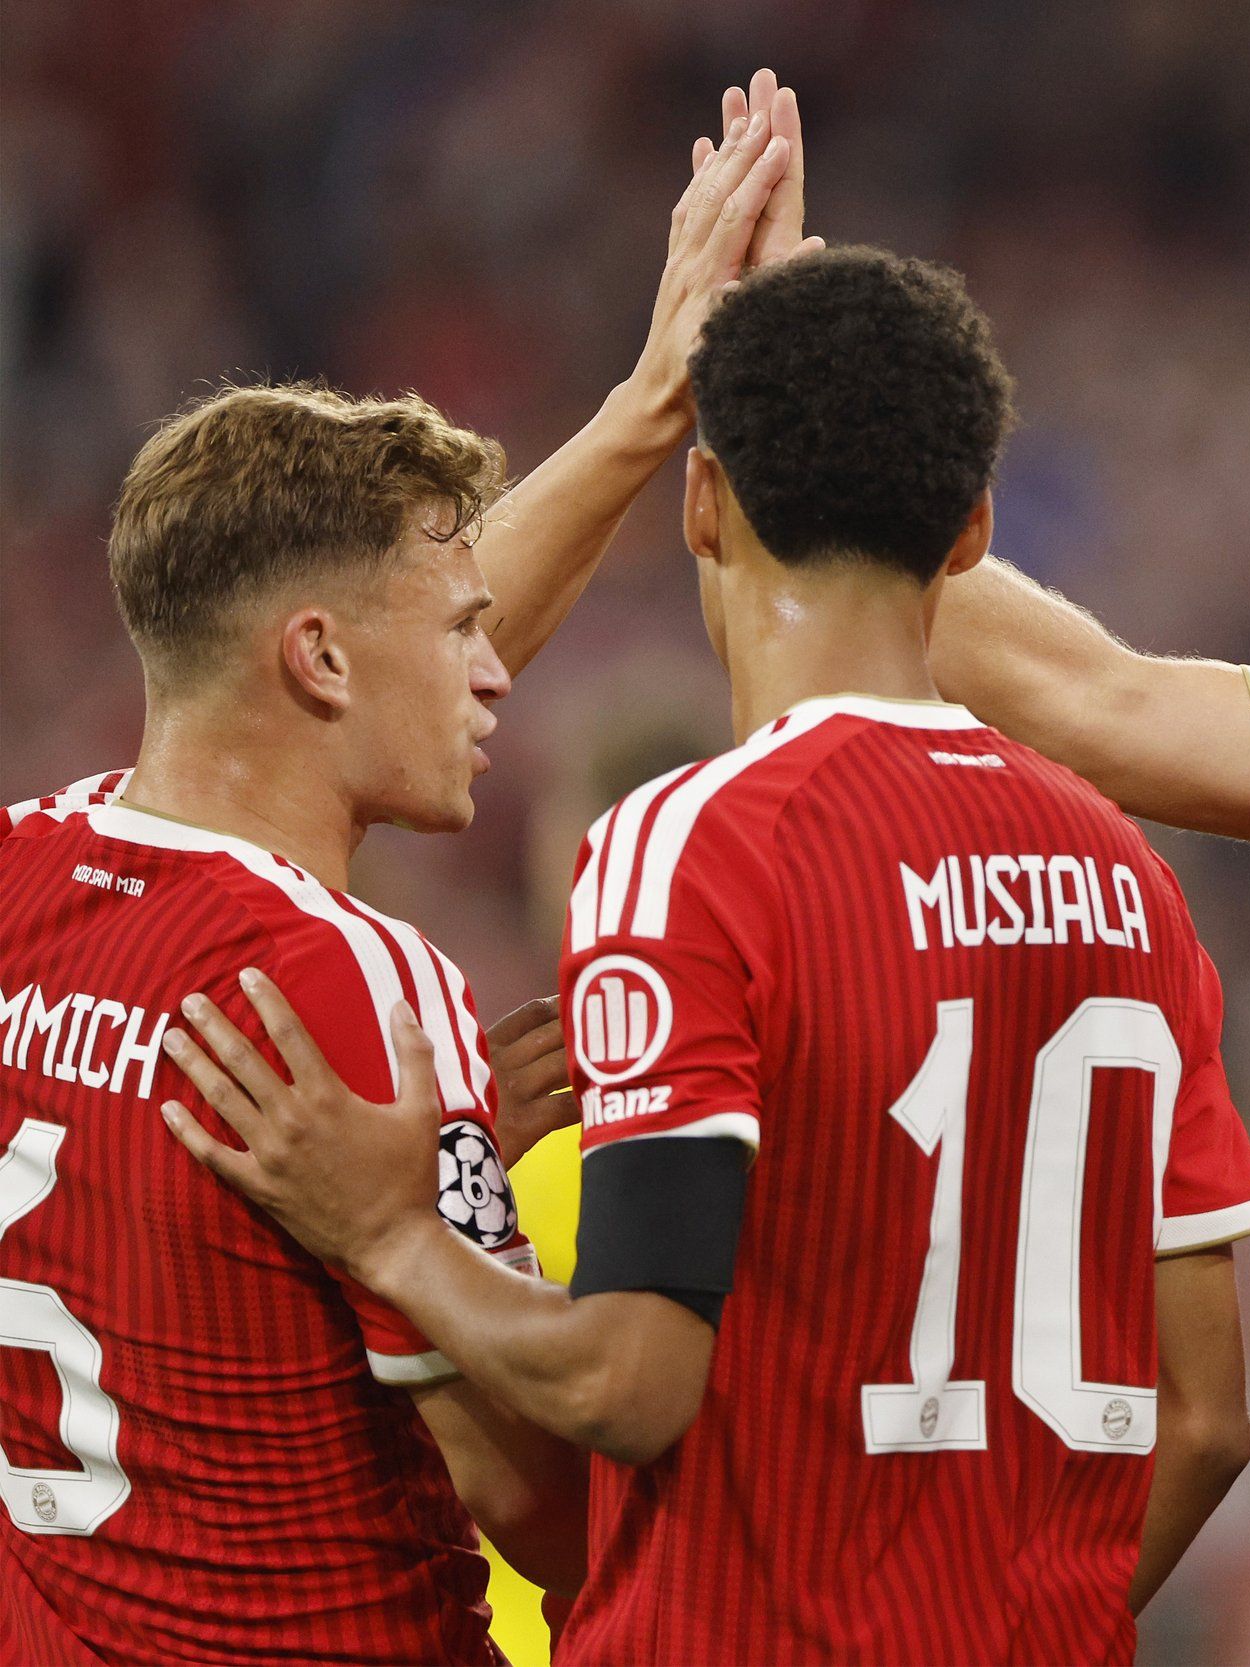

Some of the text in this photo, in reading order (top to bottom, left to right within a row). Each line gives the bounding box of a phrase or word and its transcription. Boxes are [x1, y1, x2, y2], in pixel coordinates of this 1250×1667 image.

[71, 863, 146, 898] MIA SAN MIA
[899, 854, 1151, 954] MUSIALA
[861, 996, 1182, 1455] 10
